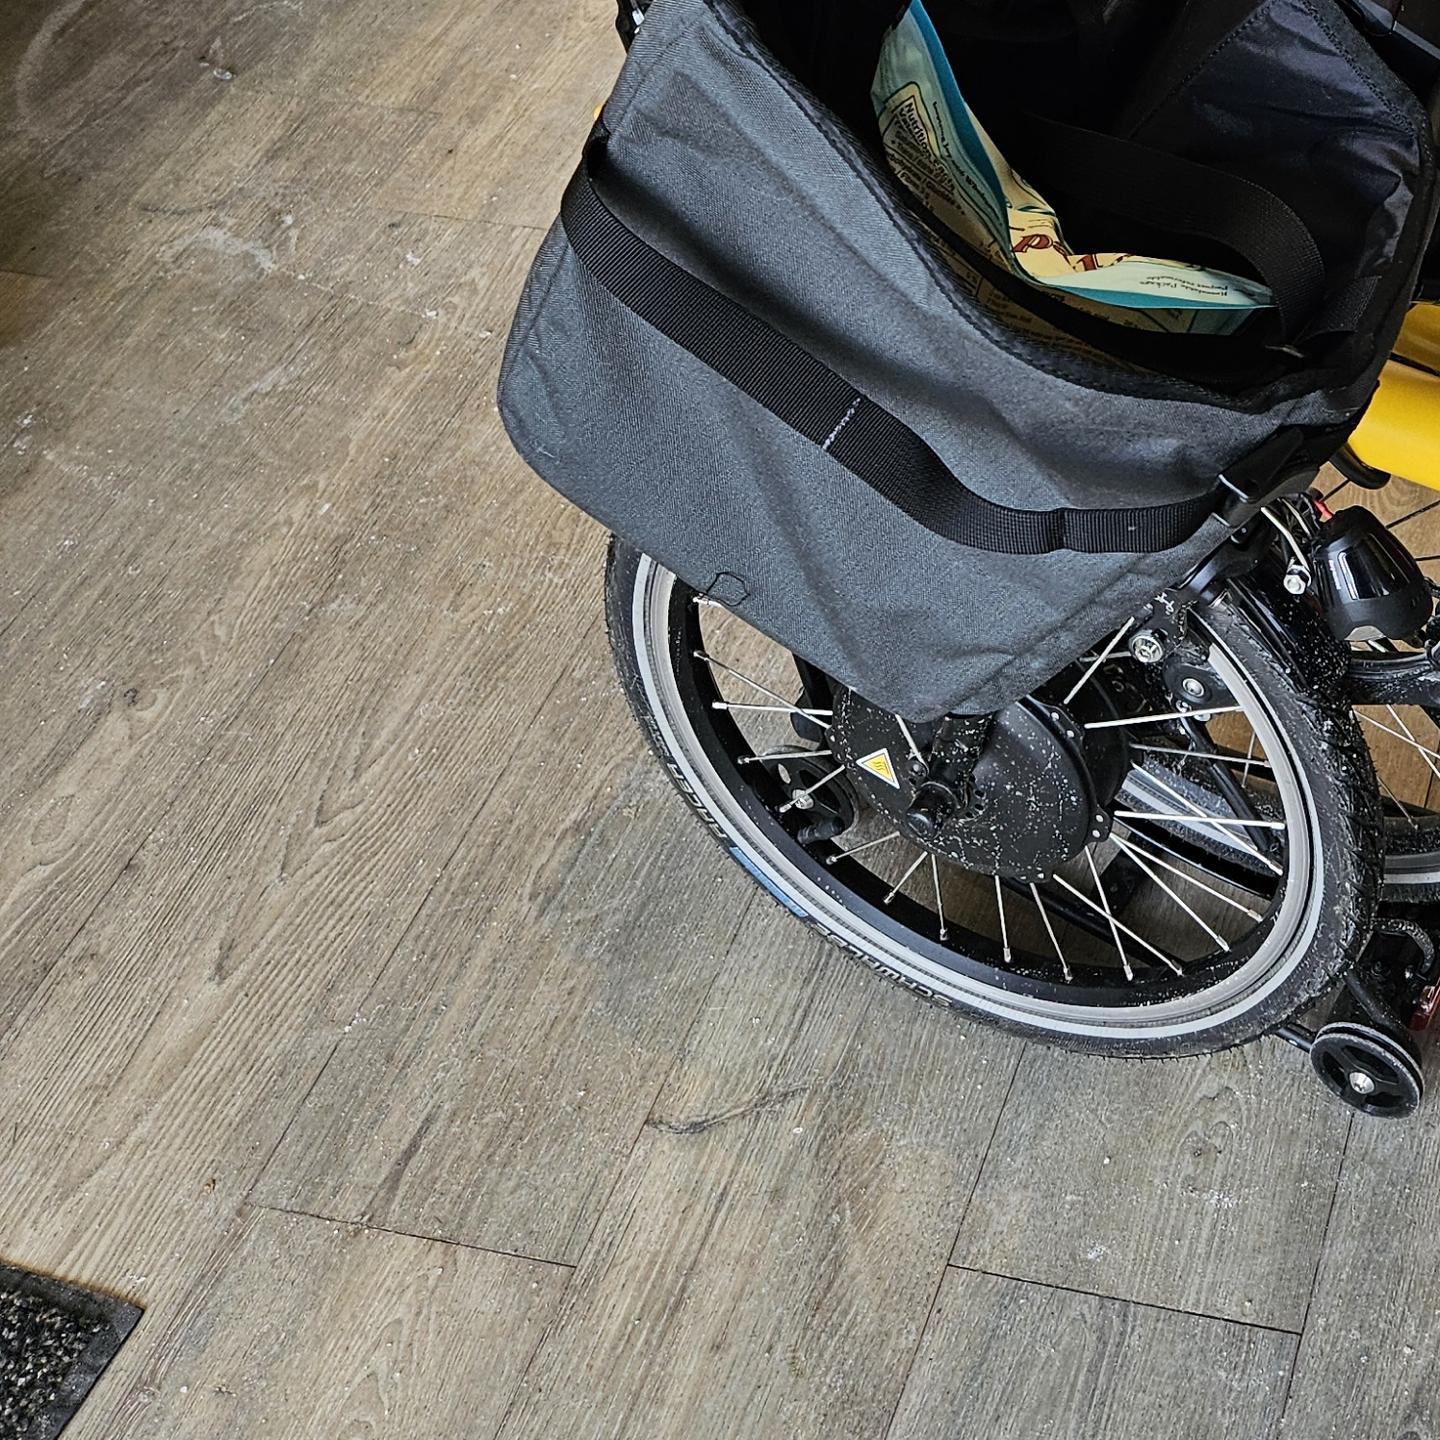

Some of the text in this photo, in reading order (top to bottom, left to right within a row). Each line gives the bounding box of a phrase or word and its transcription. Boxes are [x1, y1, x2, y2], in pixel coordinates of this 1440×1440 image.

[905, 101, 932, 160] Nutrition
[666, 762, 729, 840] RACER
[808, 921, 954, 1008] SCHWALBE
